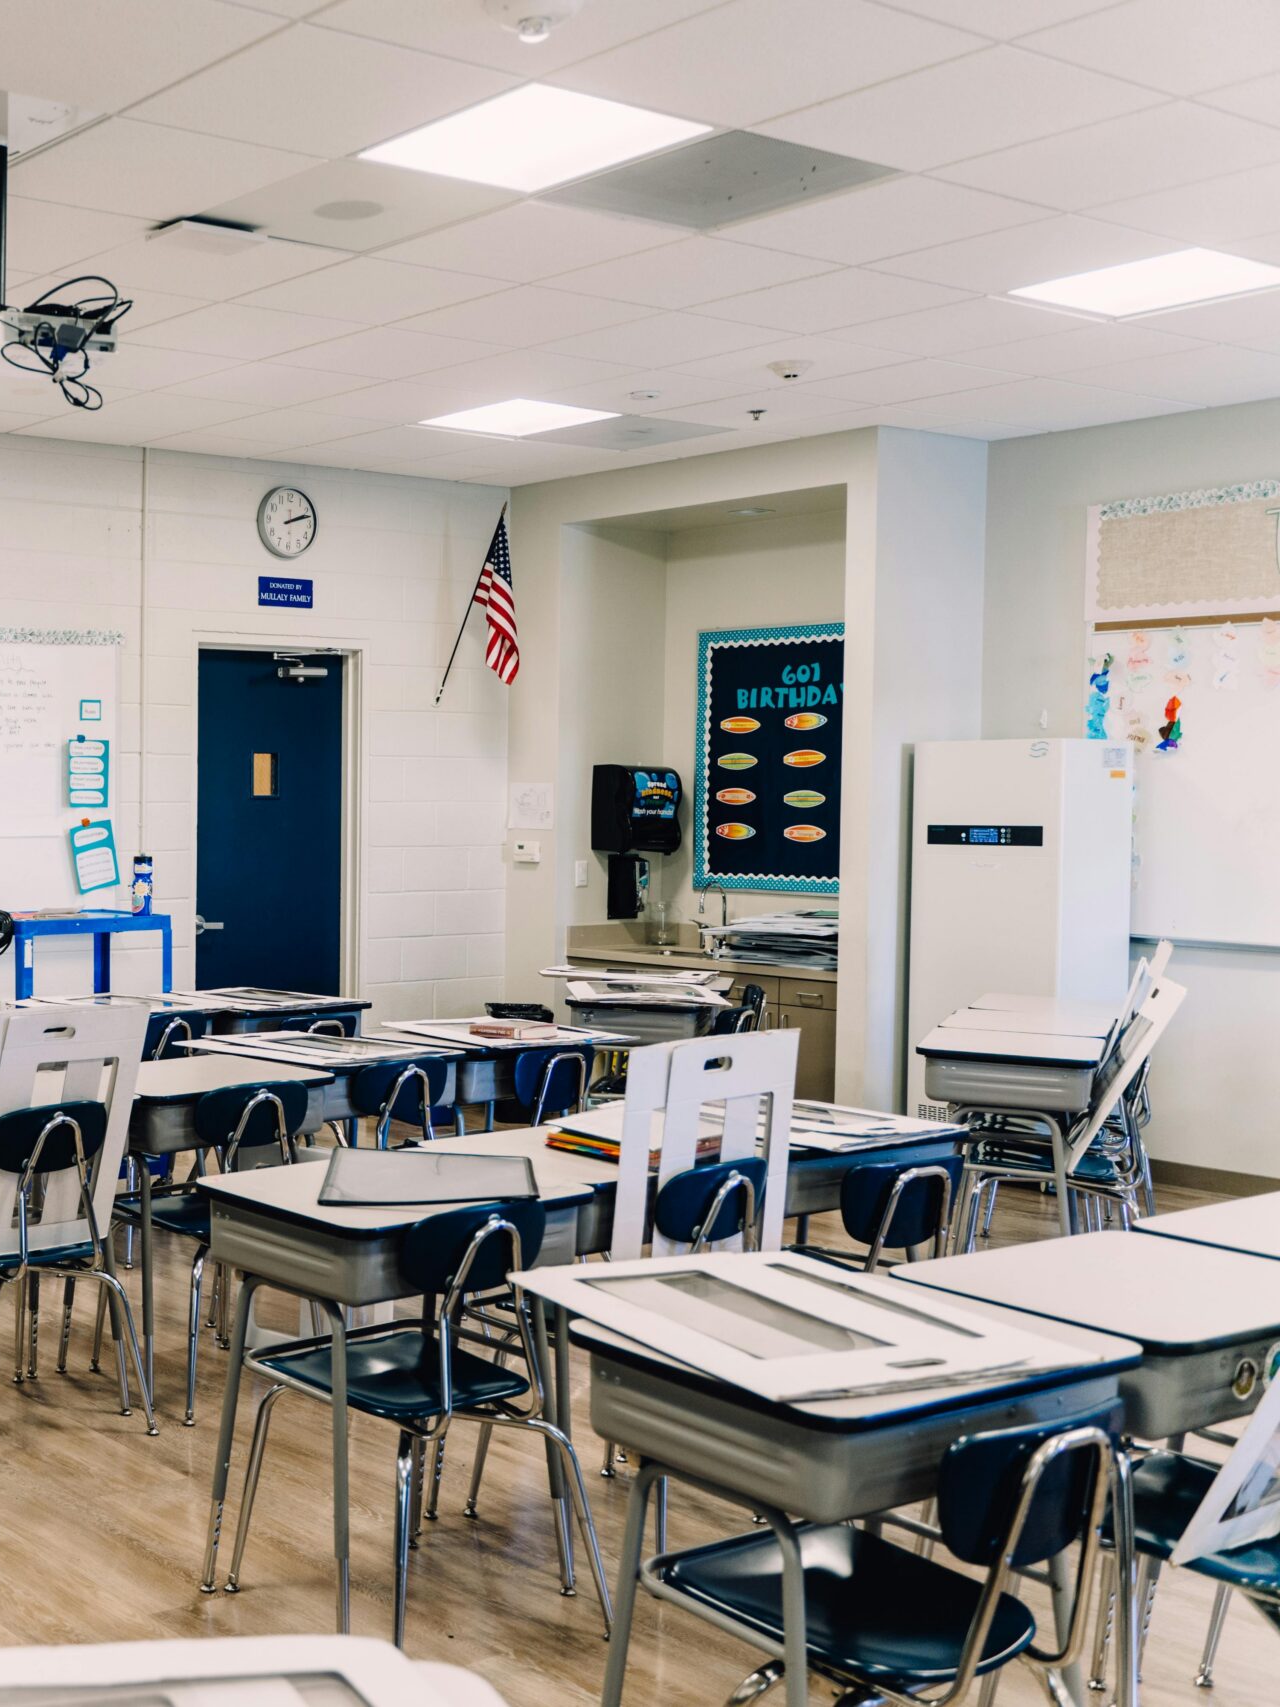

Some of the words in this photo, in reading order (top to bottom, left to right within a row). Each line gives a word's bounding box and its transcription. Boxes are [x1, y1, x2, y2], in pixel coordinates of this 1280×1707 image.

[270, 582, 295, 590] DONATED
[261, 592, 288, 601] MULLALY
[290, 594, 311, 603] FAMILY
[781, 662, 821, 685] 601
[736, 683, 844, 709] BIRTHDA
[647, 781, 667, 789] Spread
[633, 807, 646, 815] Wash
